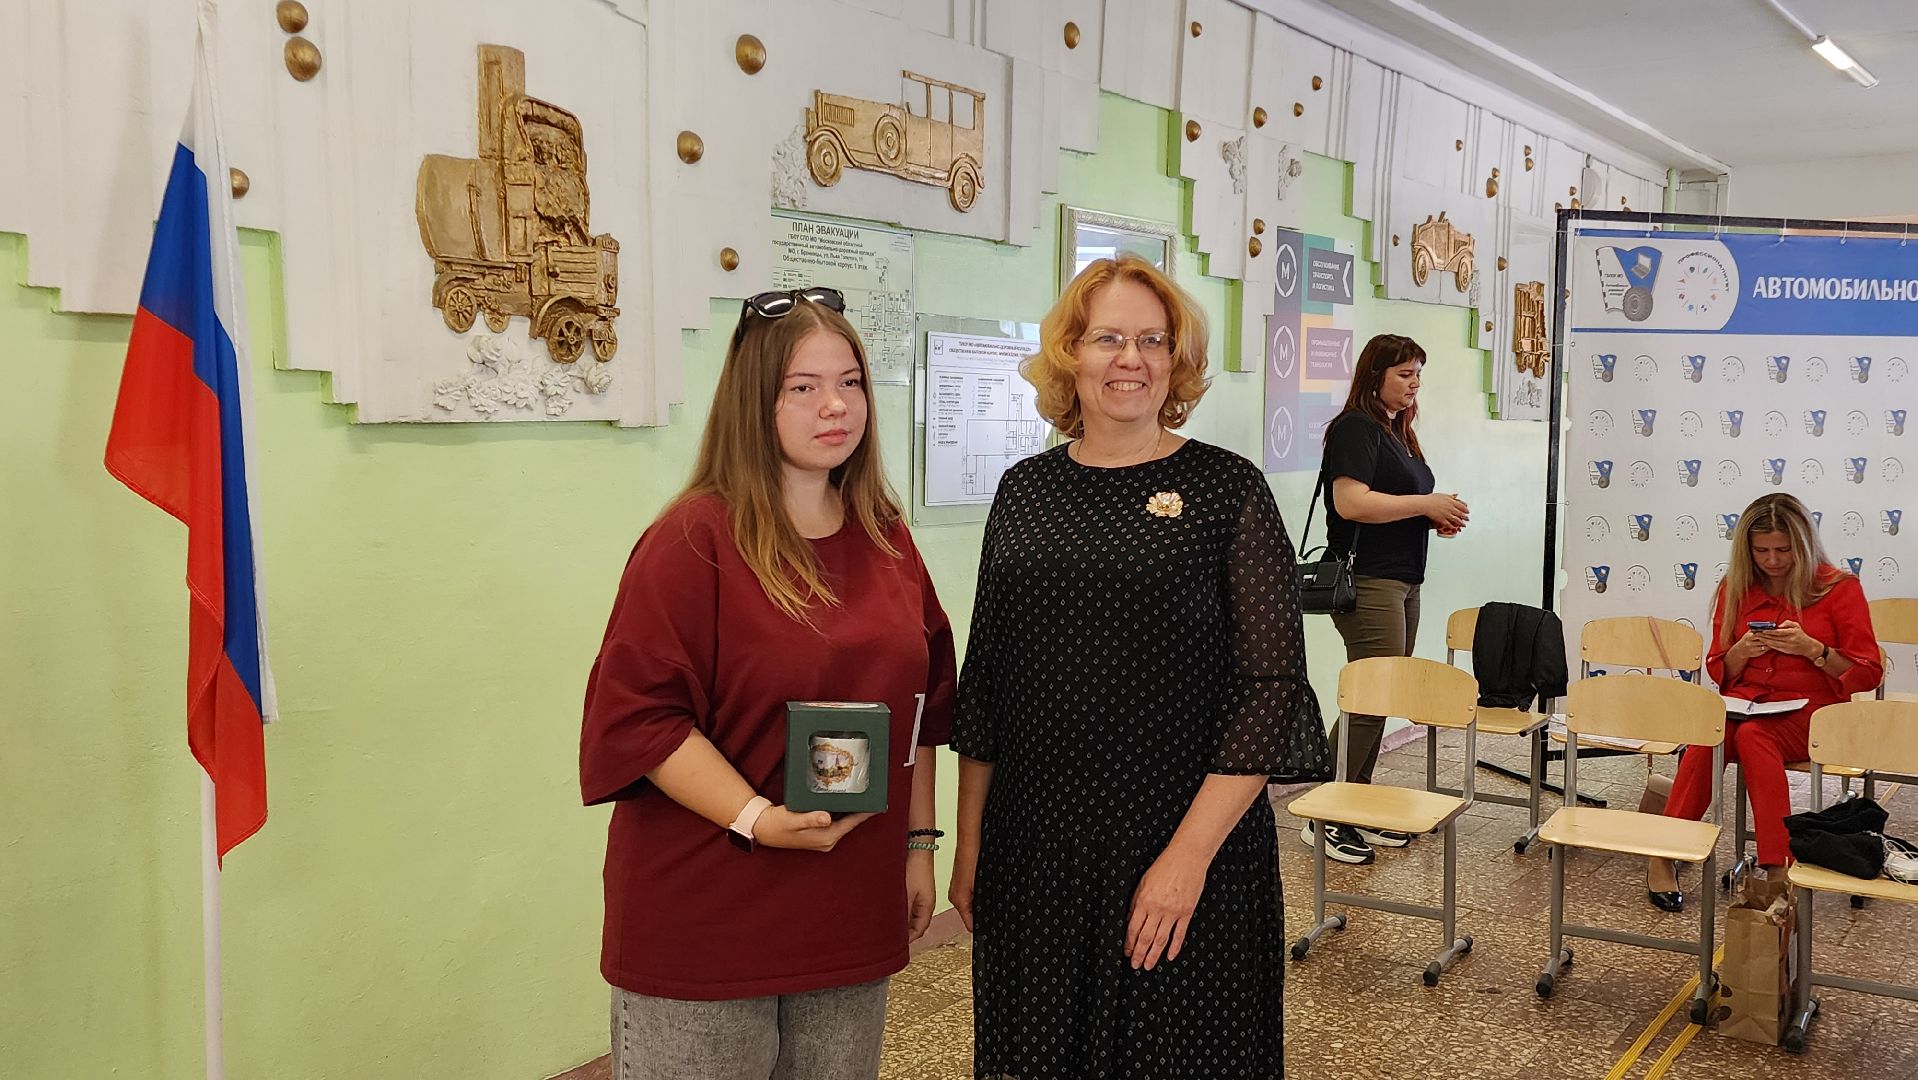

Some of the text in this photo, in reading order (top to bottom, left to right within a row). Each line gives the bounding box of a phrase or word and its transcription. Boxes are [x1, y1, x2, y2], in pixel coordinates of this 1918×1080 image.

[792, 221, 859, 240] ПЛАН ЭВАКУАЦИИ
[1753, 276, 1918, 302] АВТОМОБИЛЬНО
